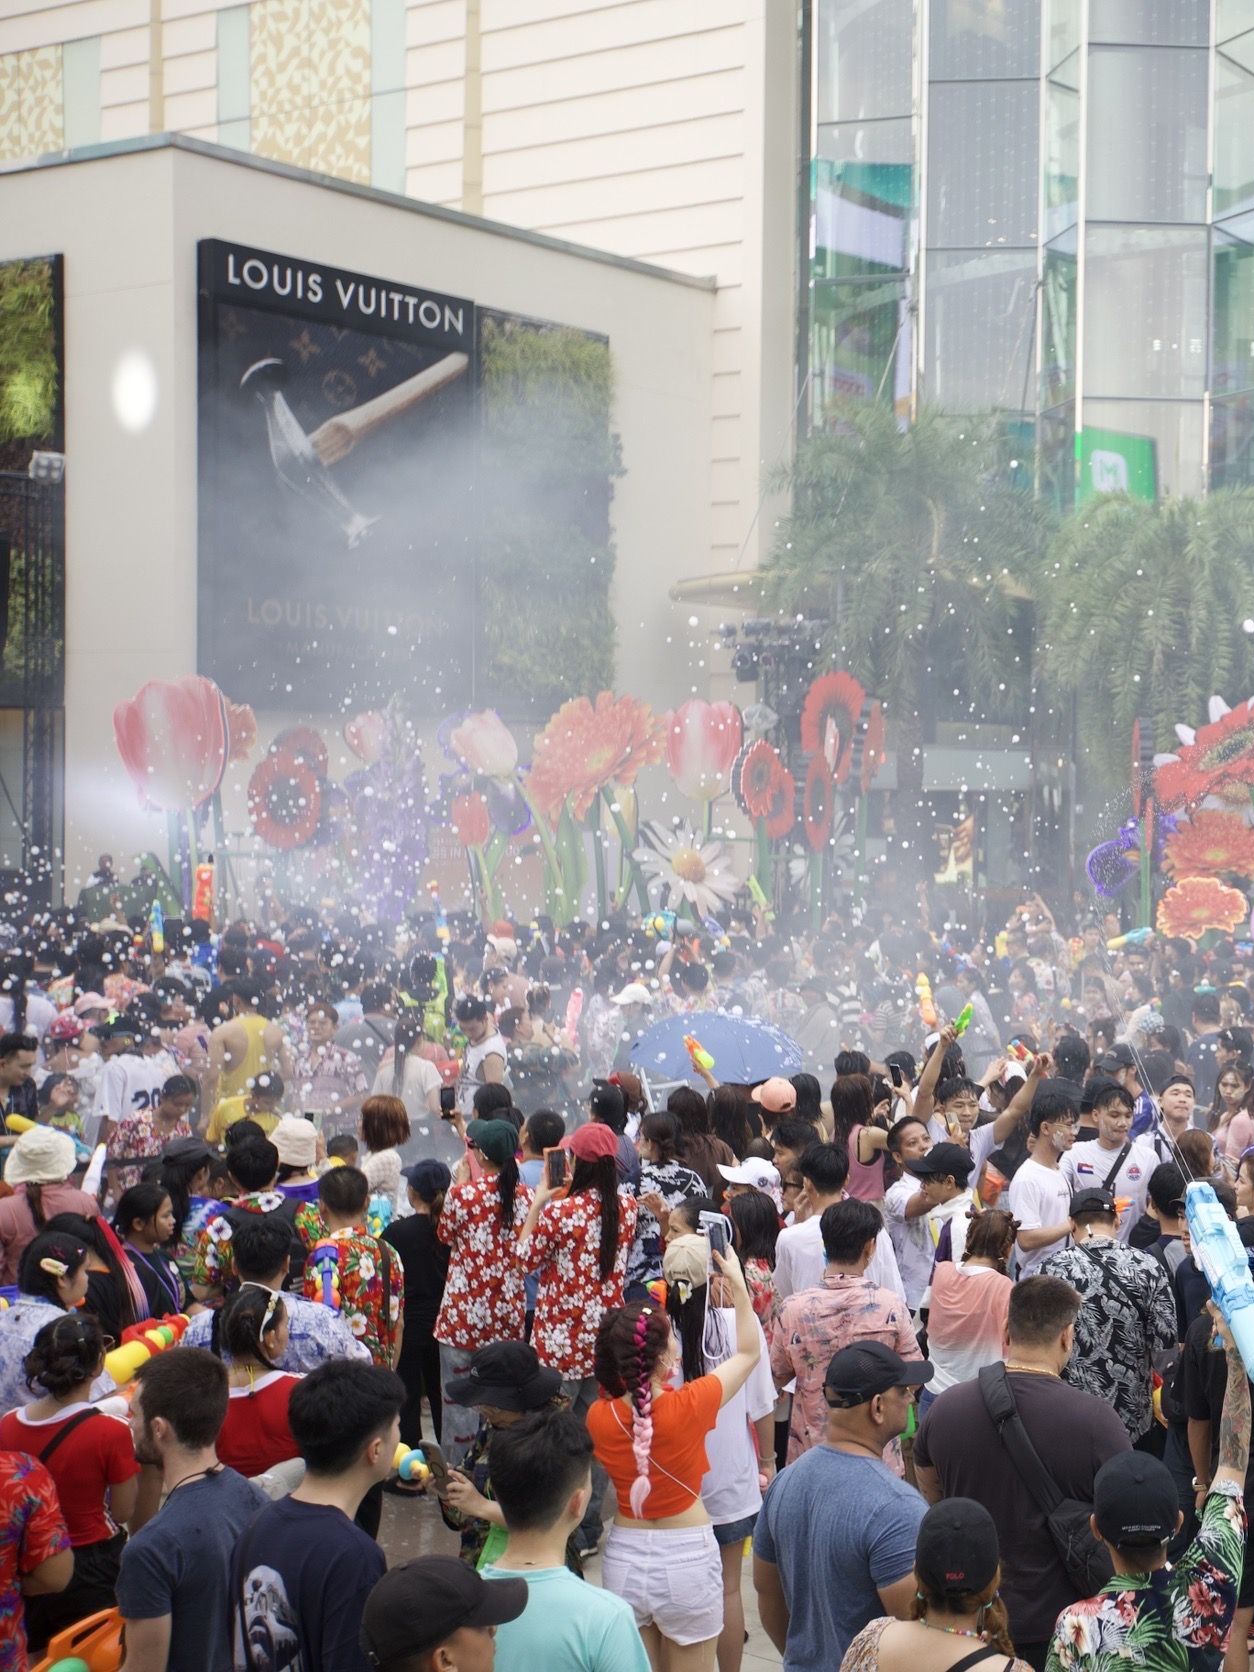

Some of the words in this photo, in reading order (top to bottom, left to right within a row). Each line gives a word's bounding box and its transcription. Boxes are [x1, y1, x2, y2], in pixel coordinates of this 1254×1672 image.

[228, 254, 323, 303] LOUIS
[335, 279, 464, 336] VUITTON
[247, 597, 328, 629] LOUIS
